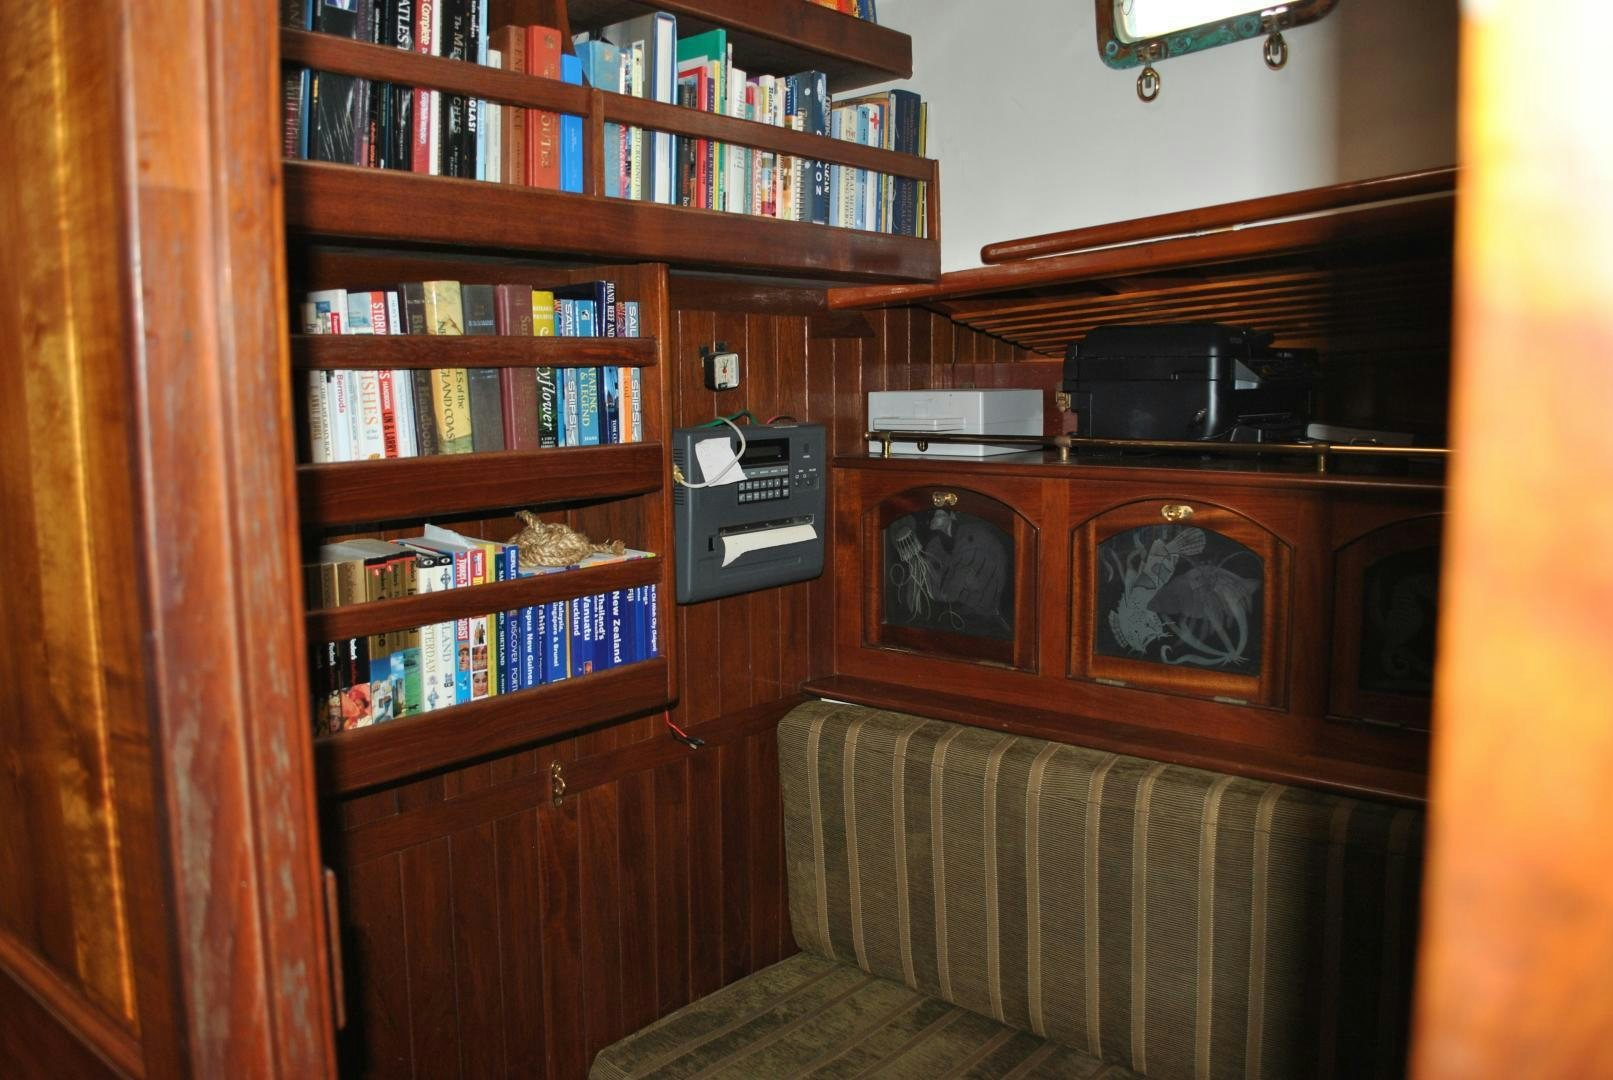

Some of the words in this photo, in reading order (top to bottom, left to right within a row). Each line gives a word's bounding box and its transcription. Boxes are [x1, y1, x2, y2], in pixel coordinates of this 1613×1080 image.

[420, 3, 431, 45] Complete
[606, 283, 615, 304] HAND,
[373, 302, 384, 335] STORM
[607, 324, 615, 337] AND
[457, 385, 463, 394] of
[580, 372, 588, 380] &
[336, 374, 346, 413] Bermuda
[361, 375, 378, 426] ISHES
[536, 367, 555, 430] yflower
[581, 384, 590, 426] LEGEND
[383, 412, 392, 424] LIN
[444, 408, 455, 439] COAS
[385, 432, 397, 452] LARRY
[583, 596, 591, 640] Vanuatu
[613, 619, 622, 663] Zealand
